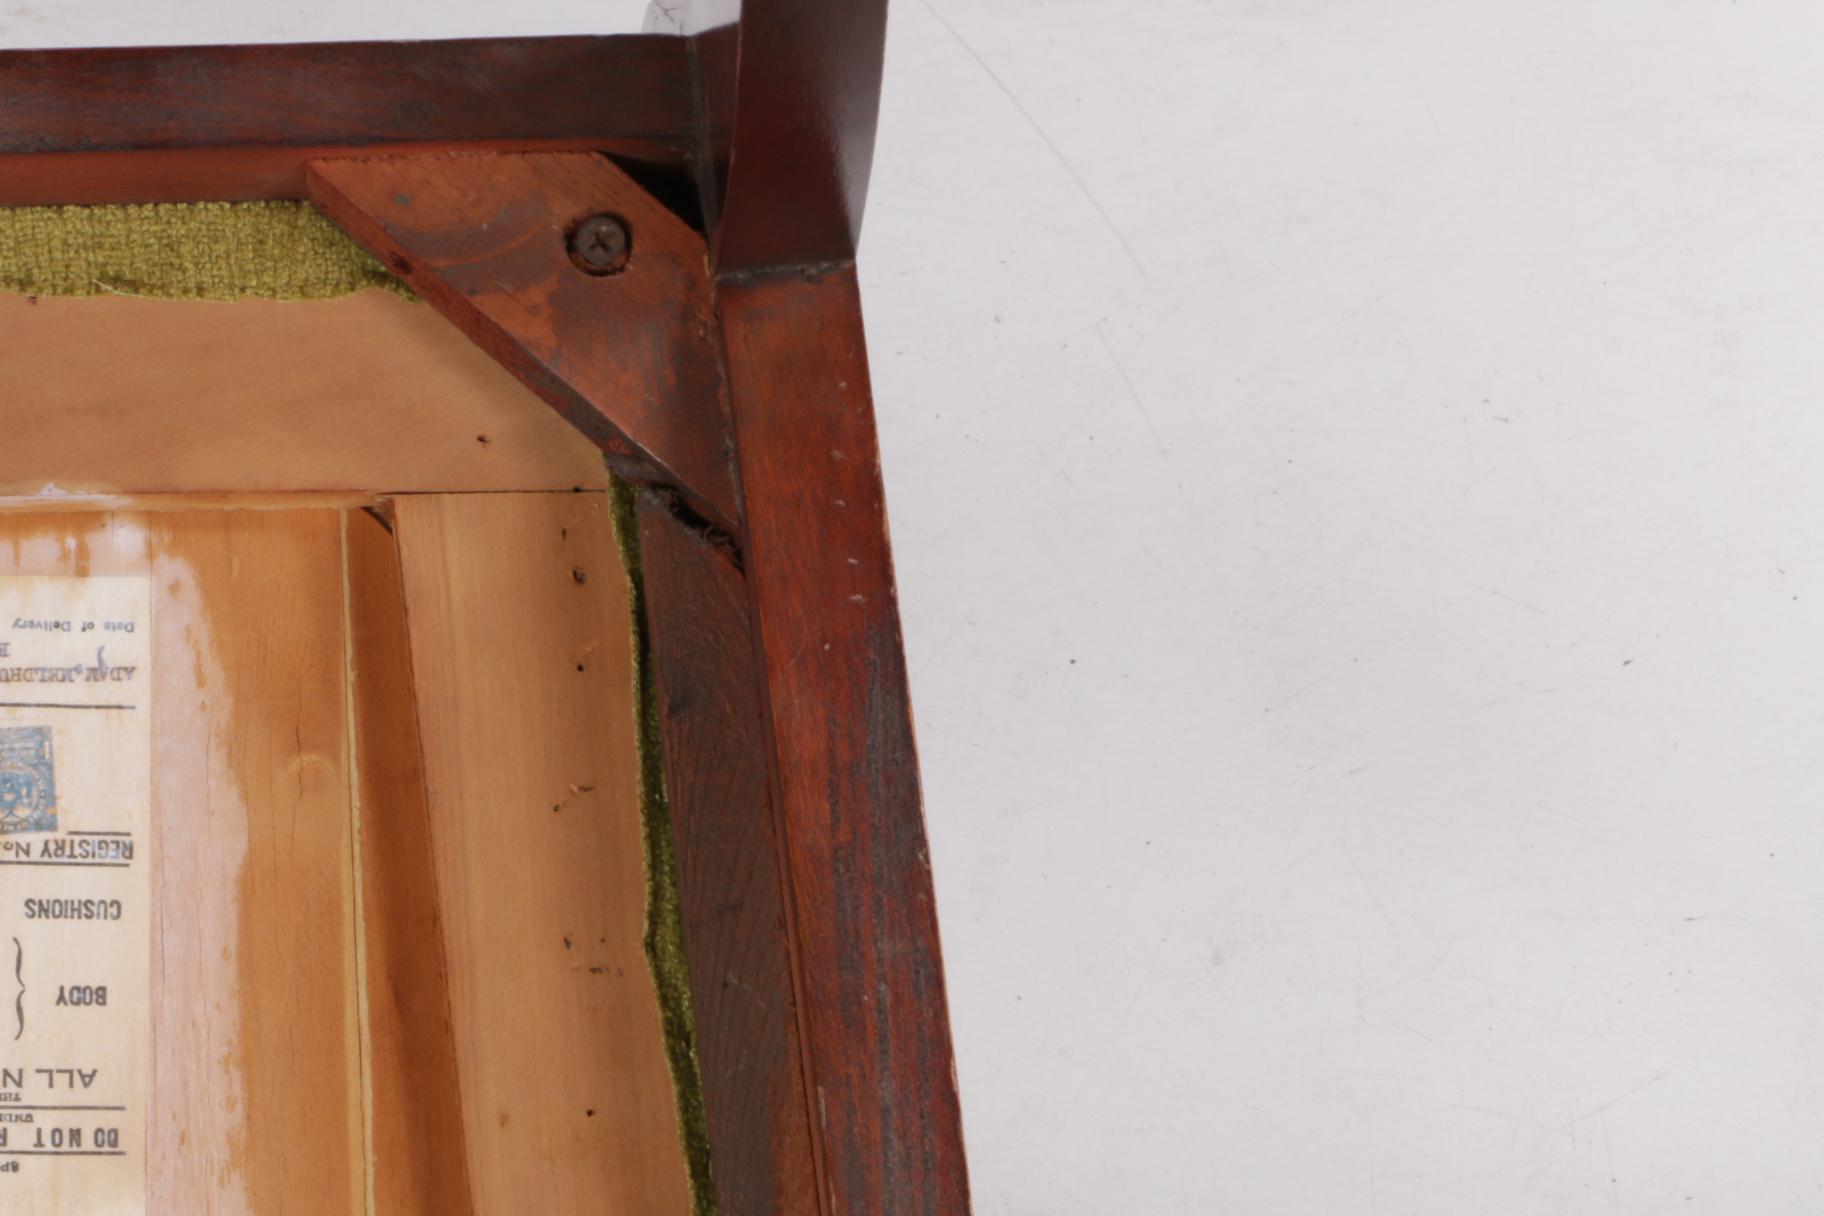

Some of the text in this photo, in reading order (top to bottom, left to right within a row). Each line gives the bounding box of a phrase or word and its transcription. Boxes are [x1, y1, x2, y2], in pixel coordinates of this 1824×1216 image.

[11, 619, 135, 633] Date of Delivery
[40, 838, 134, 860] REGISTRY
[24, 898, 122, 920] CUSHIONS
[56, 985, 108, 1006] BODY
[35, 1068, 97, 1088] ALL
[33, 1127, 82, 1148] NOT
[94, 1127, 119, 1148] DO
